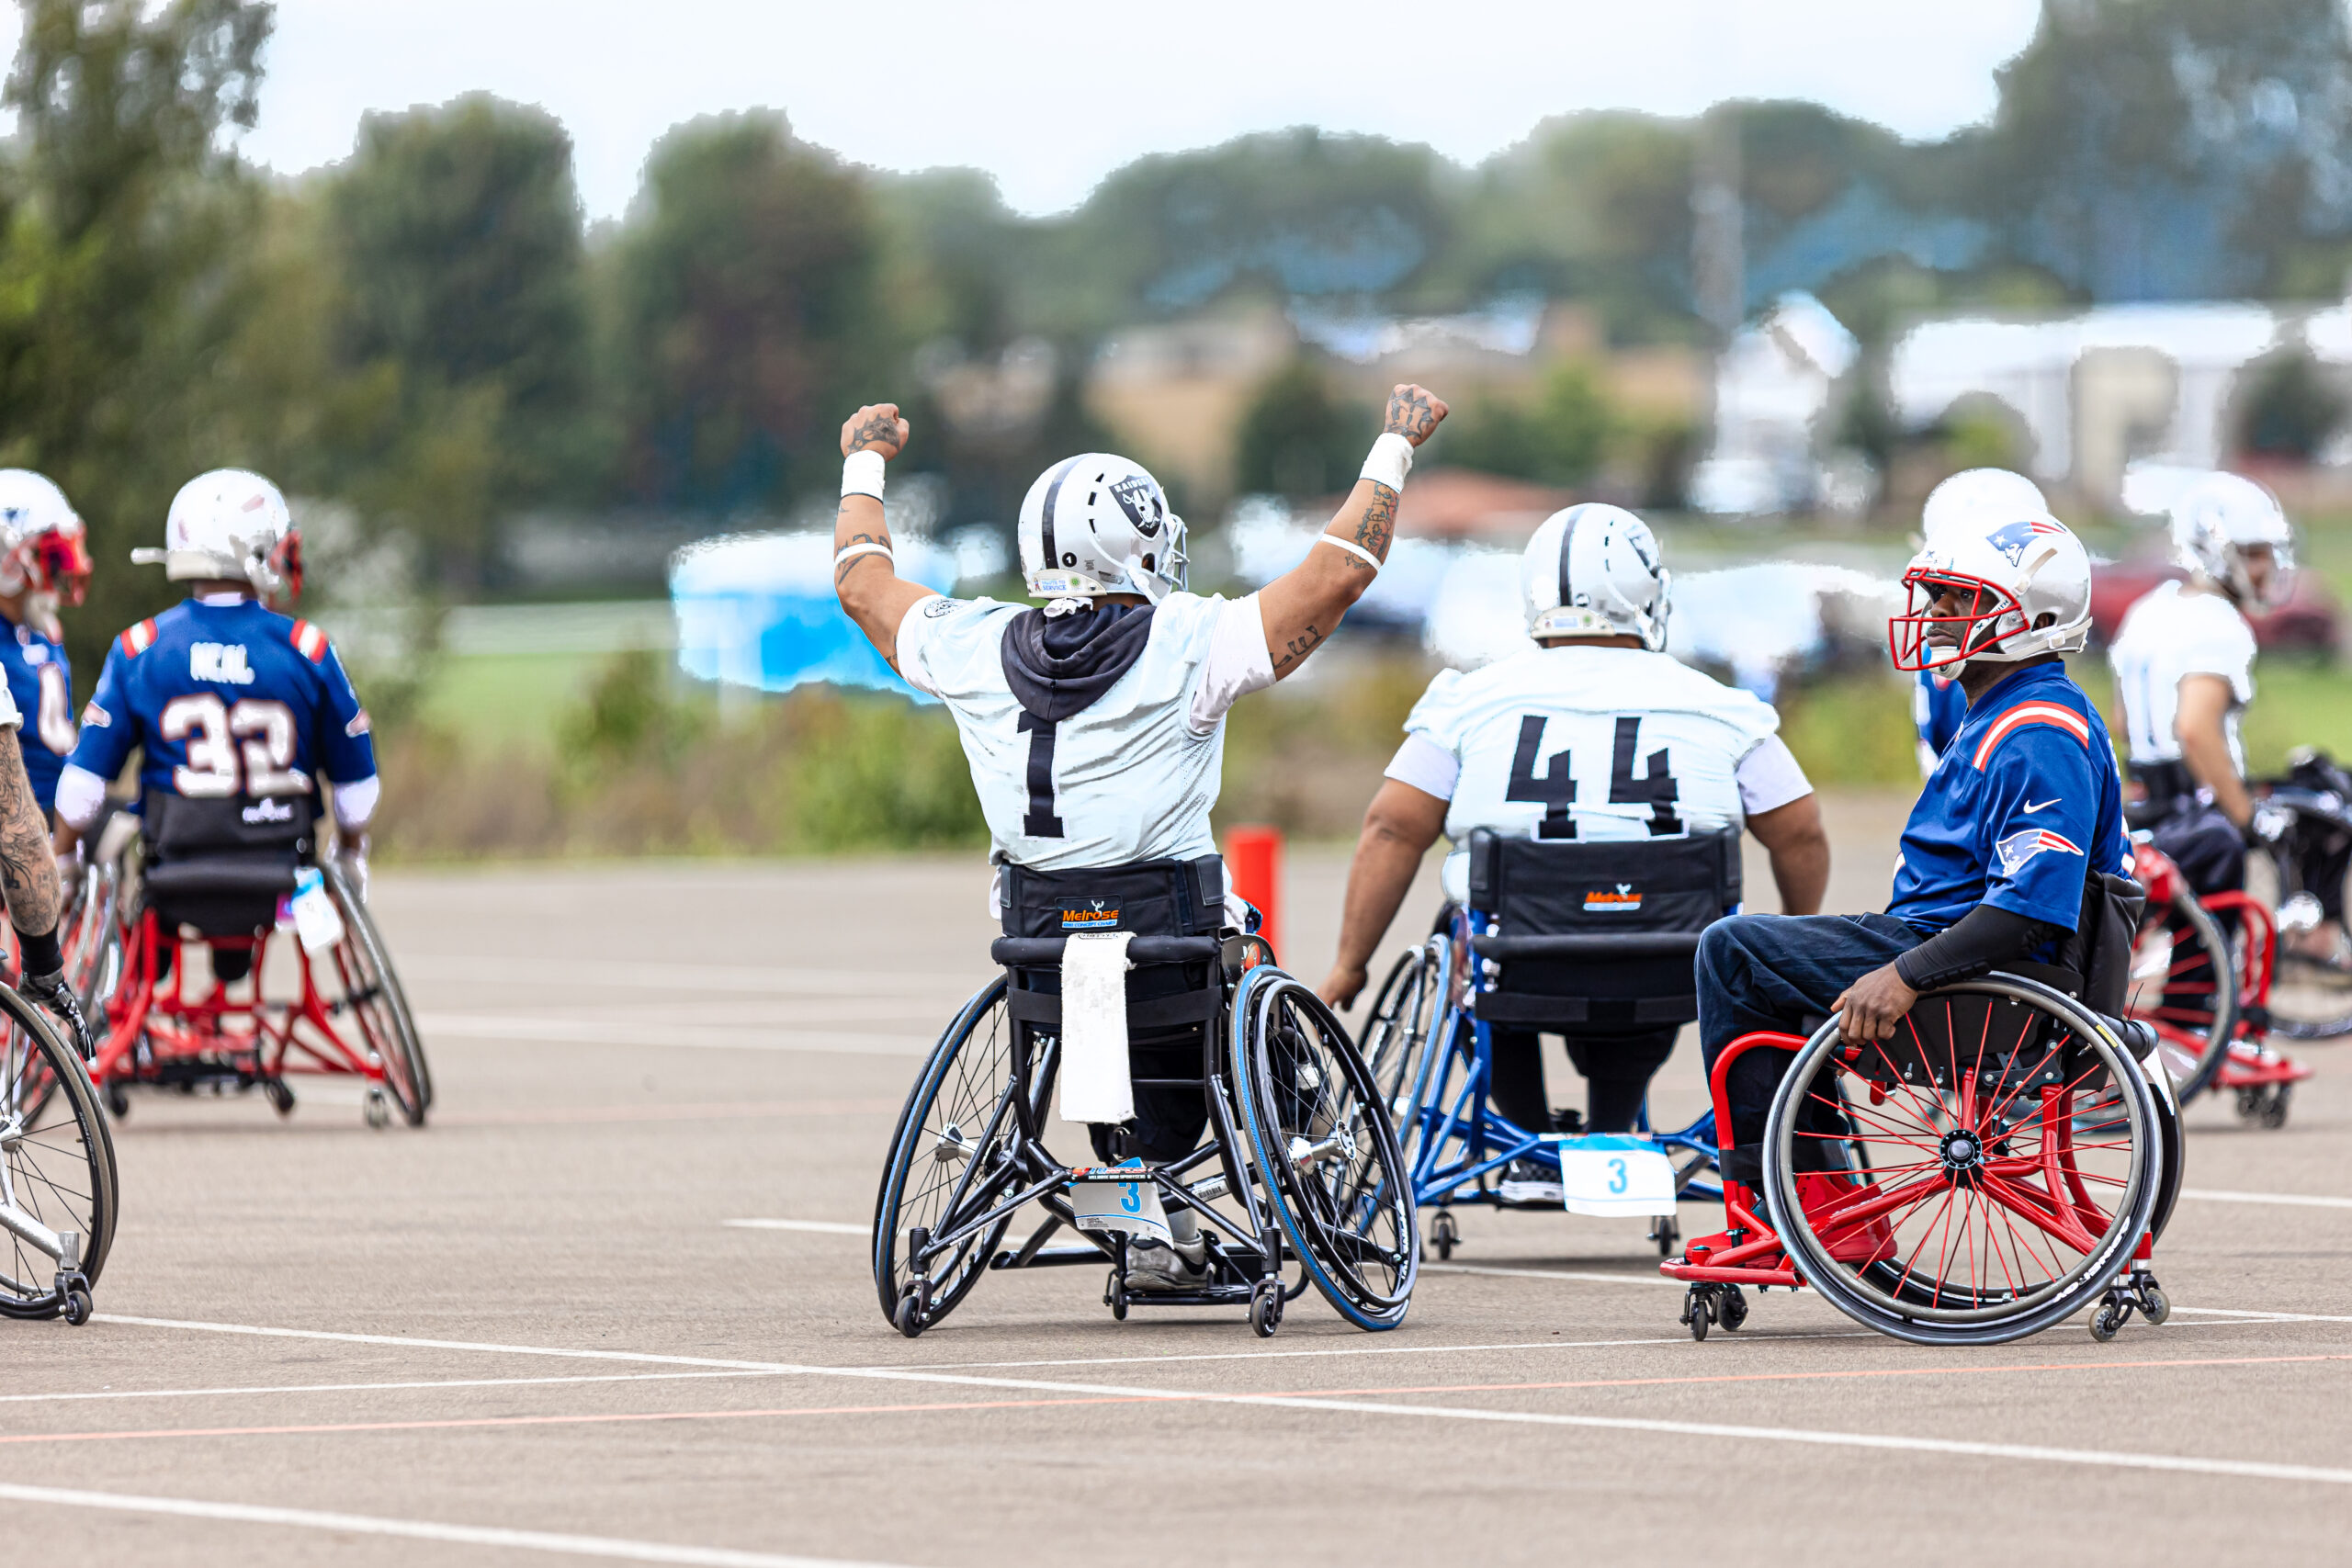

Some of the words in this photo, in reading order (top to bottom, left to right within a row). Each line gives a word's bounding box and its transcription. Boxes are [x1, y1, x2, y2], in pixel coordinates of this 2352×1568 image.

[159, 692, 313, 797] 32
[1017, 710, 1065, 838] 1
[1505, 715, 1683, 839] 44
[1062, 909, 1119, 921] Melrose
[1117, 1181, 1142, 1213] 3
[1607, 1157, 1627, 1195] 3
